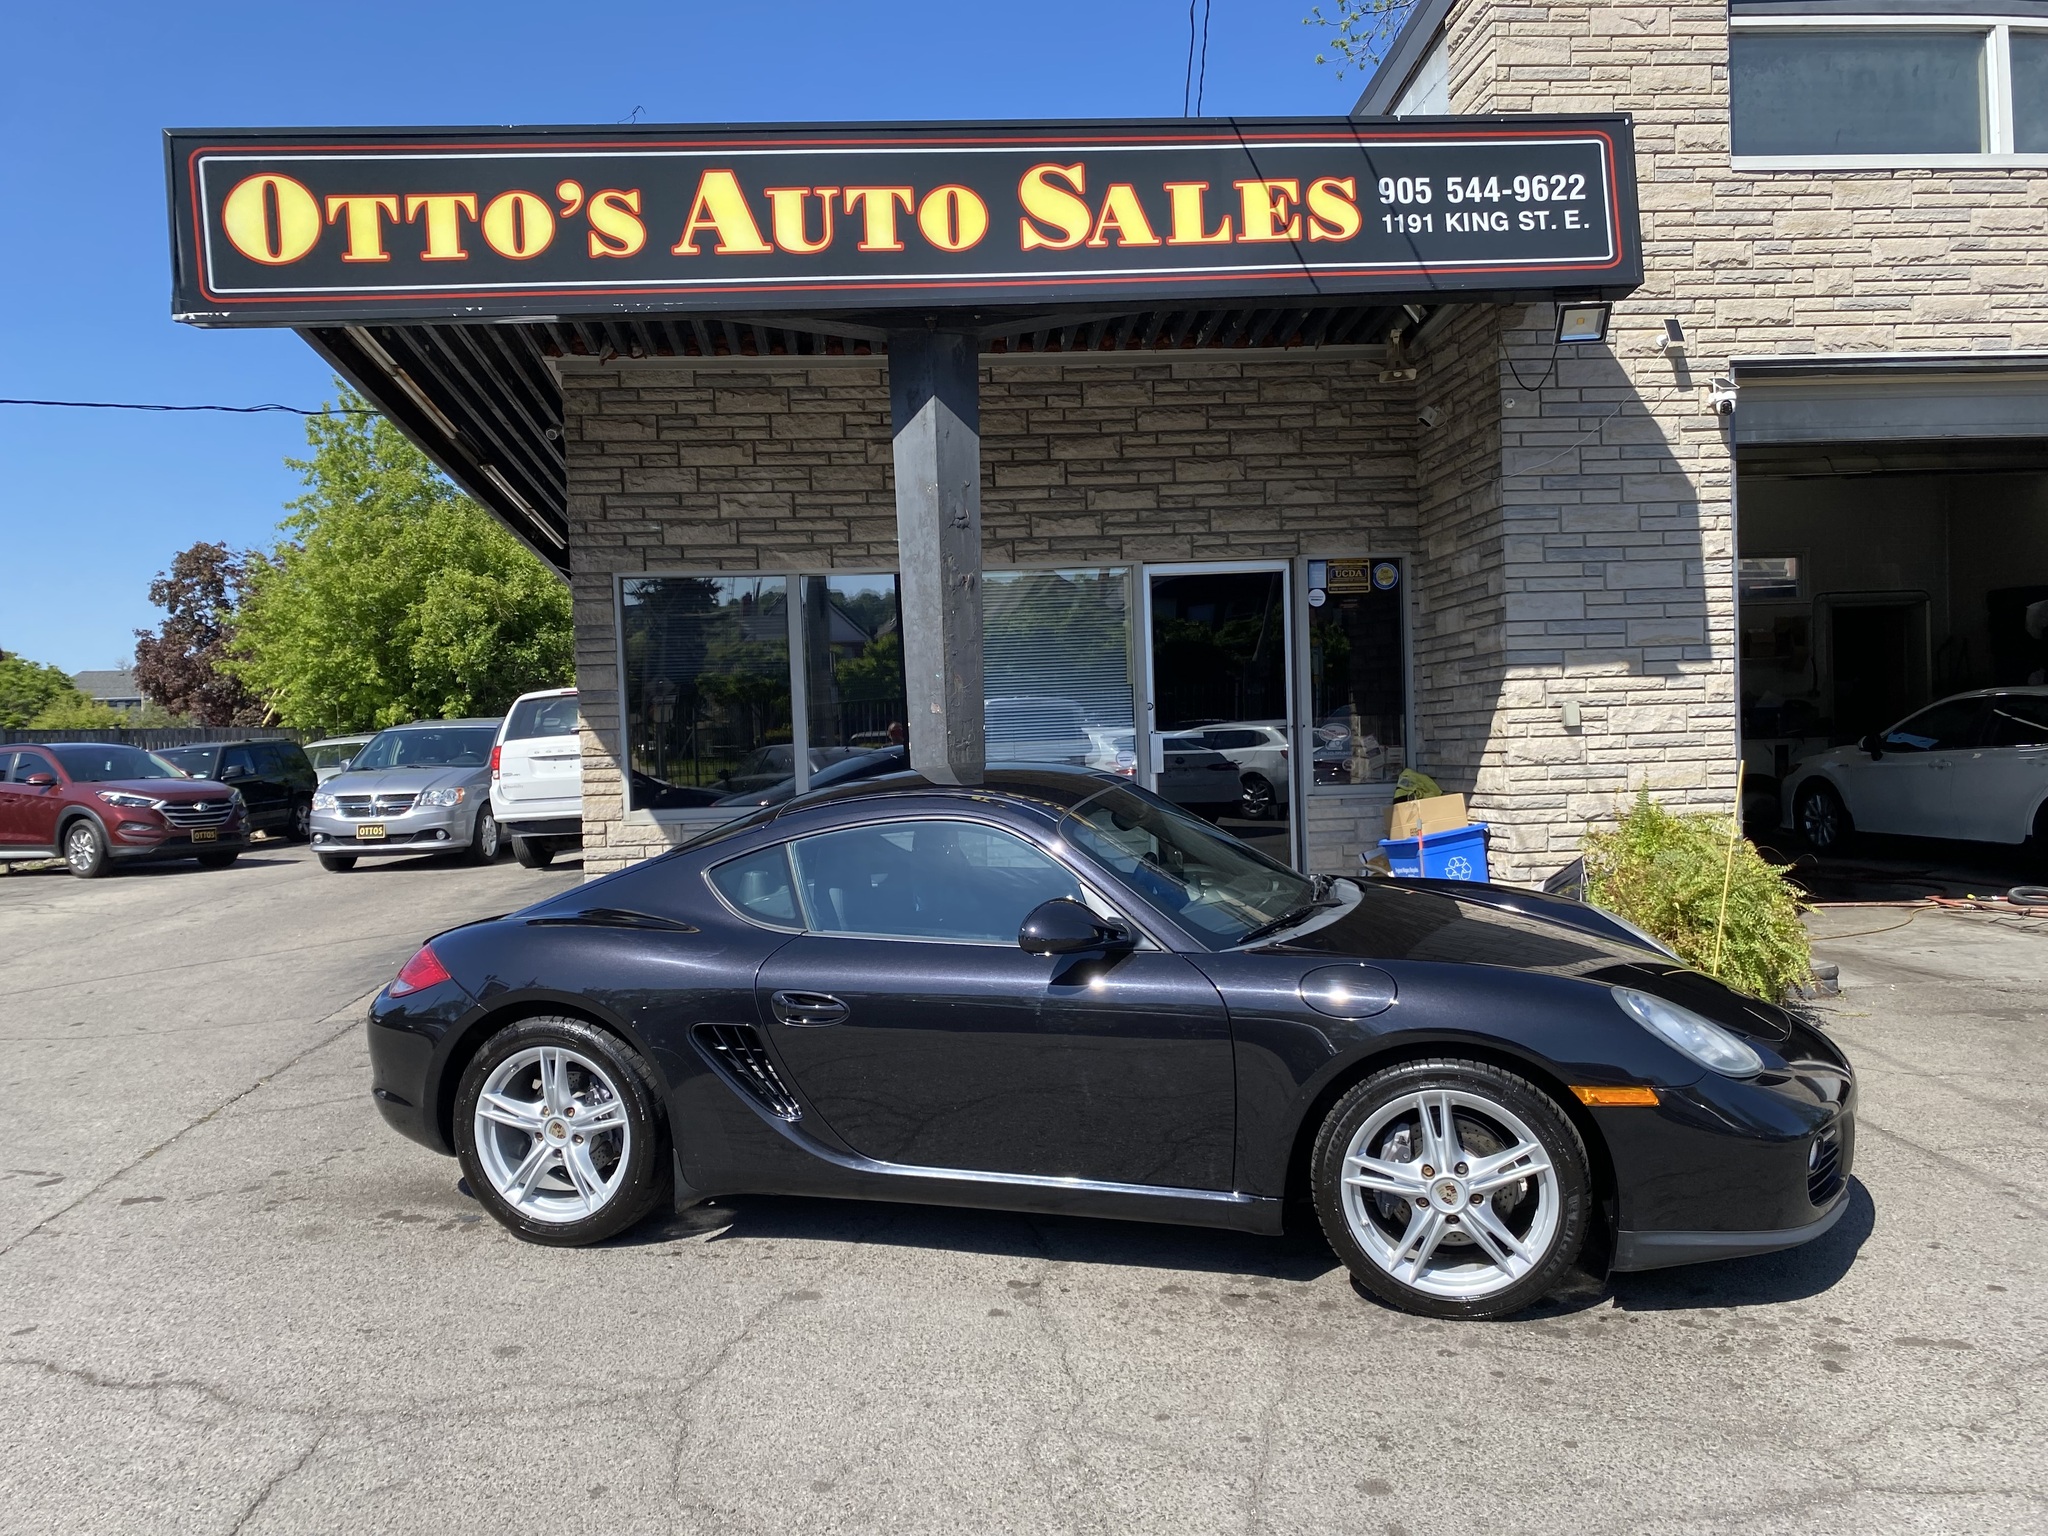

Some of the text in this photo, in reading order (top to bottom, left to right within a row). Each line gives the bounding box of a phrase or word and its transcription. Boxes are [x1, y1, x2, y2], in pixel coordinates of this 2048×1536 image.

[1378, 173, 1586, 205] 905 544-9622
[671, 168, 989, 256] AUTO
[1018, 162, 1363, 252] SALES
[1382, 209, 1591, 234] 1191 KING ST. E.
[1335, 569, 1363, 578] UCDA
[194, 830, 215, 840] OTTOS
[360, 827, 383, 837] OTTOS
